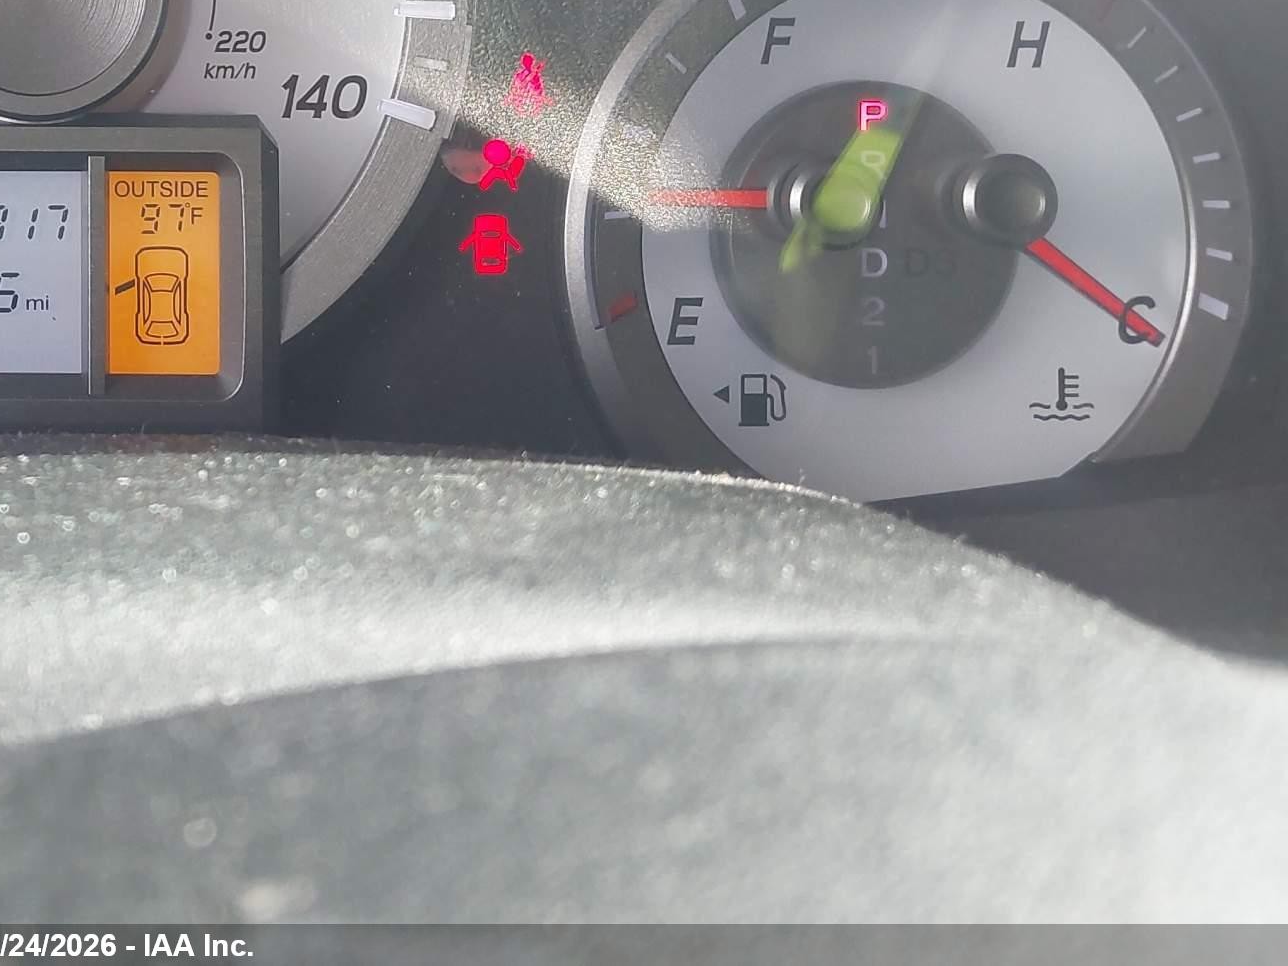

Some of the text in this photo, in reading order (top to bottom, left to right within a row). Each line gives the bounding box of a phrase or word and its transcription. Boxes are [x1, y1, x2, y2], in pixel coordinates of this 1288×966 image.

[214, 30, 267, 53] 220
[760, 17, 796, 65] F
[1007, 20, 1051, 69] H
[203, 61, 258, 82] km/h
[282, 74, 368, 119] 140
[860, 100, 888, 131] P
[114, 180, 209, 199] OUTSIDE
[862, 248, 888, 277] D
[25, 296, 50, 312] mi
[862, 297, 885, 326] 2
[667, 297, 707, 346] E
[1119, 296, 1156, 345] C
[866, 345, 879, 375] 1
